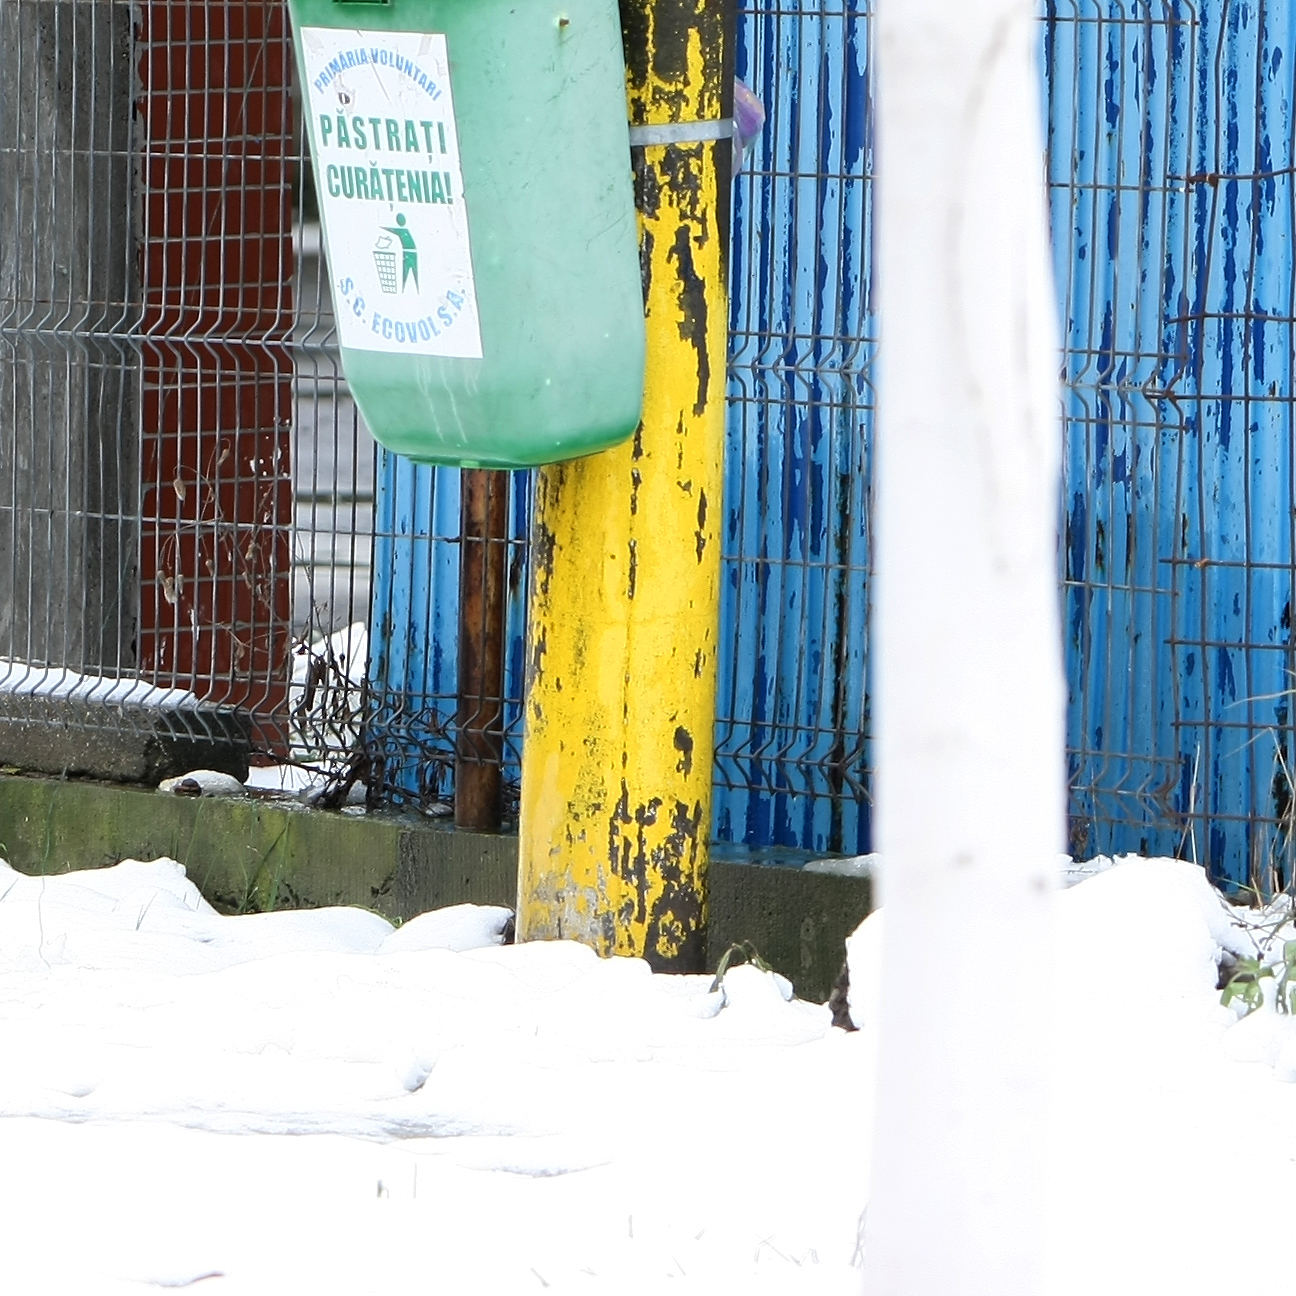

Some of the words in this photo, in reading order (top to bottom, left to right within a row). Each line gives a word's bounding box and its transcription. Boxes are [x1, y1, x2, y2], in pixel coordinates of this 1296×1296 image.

[313, 47, 369, 95] PRIMĂRIA
[369, 47, 443, 102] VOLUNTARI
[319, 107, 448, 164] PĂSTRAȚI
[371, 311, 442, 344] ECOVOL
